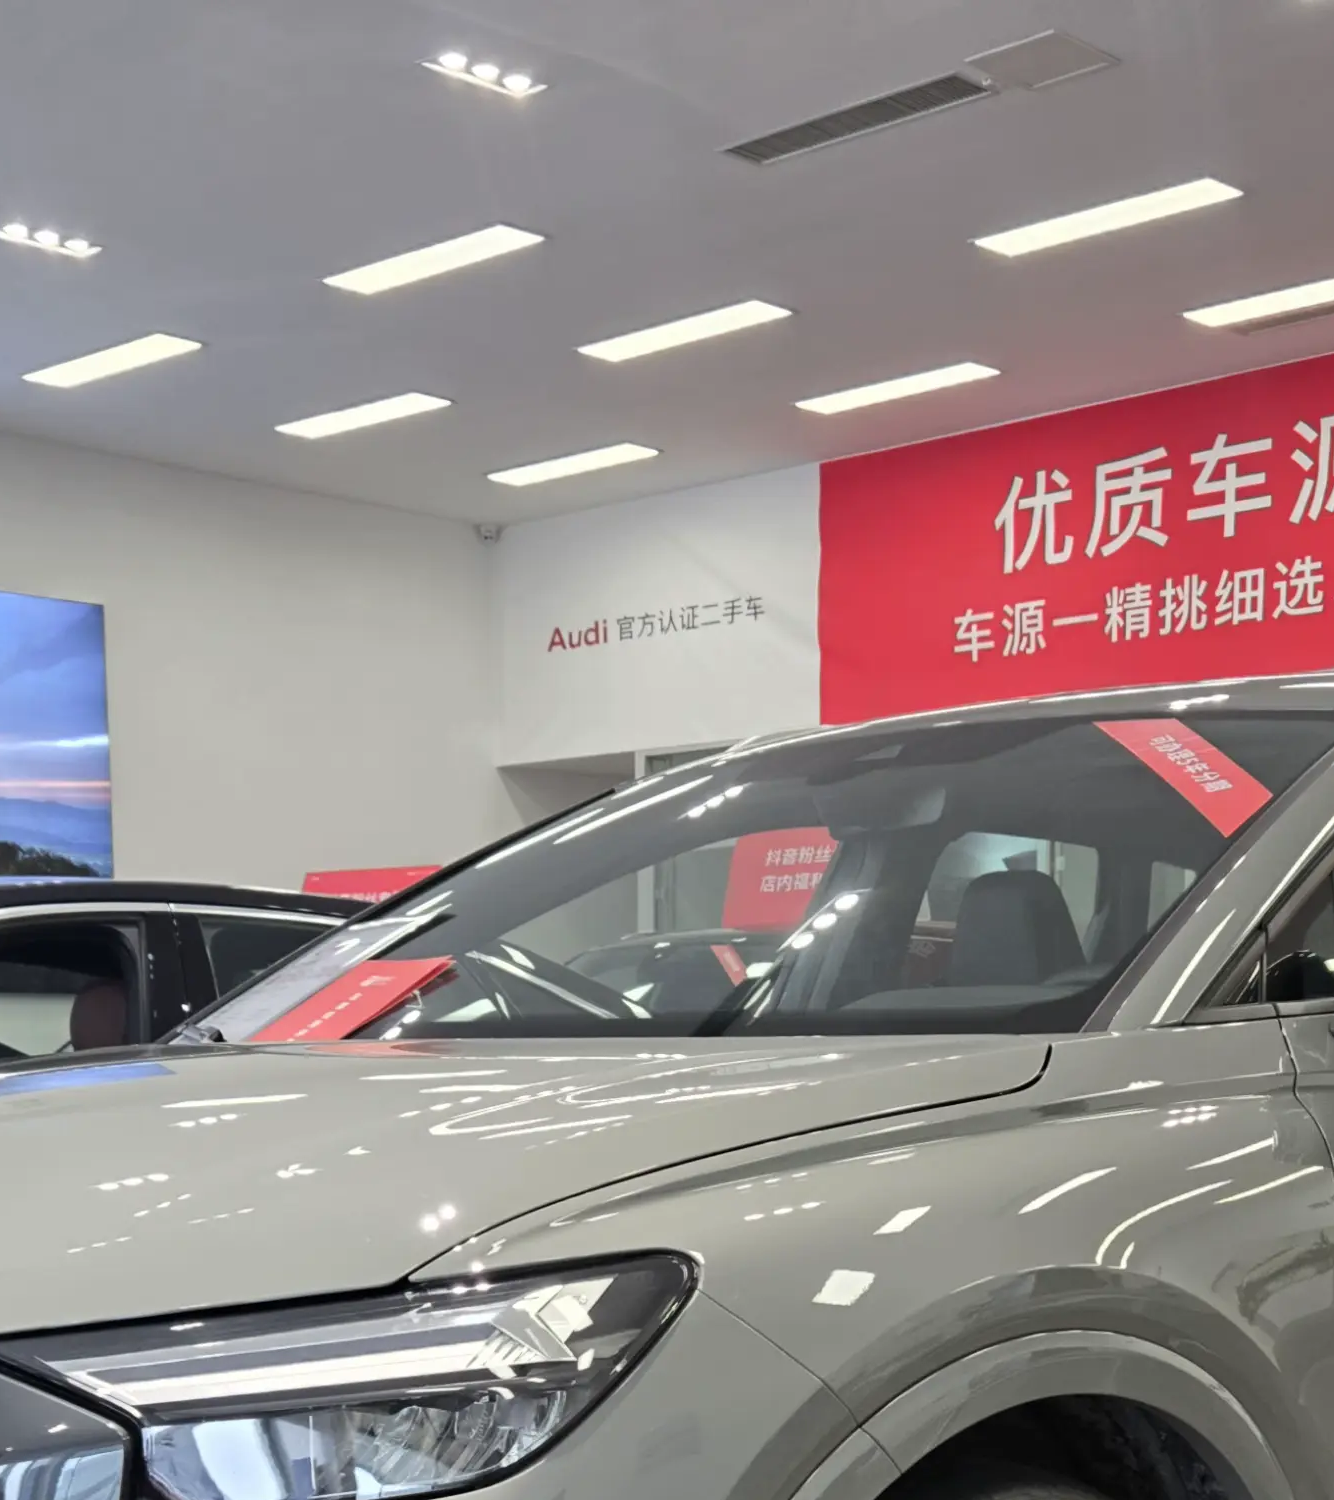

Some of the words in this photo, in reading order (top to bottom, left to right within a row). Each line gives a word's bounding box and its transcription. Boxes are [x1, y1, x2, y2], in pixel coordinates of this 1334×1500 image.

[547, 620, 609, 652] Audi
[617, 596, 766, 641] 官方认证二手车
